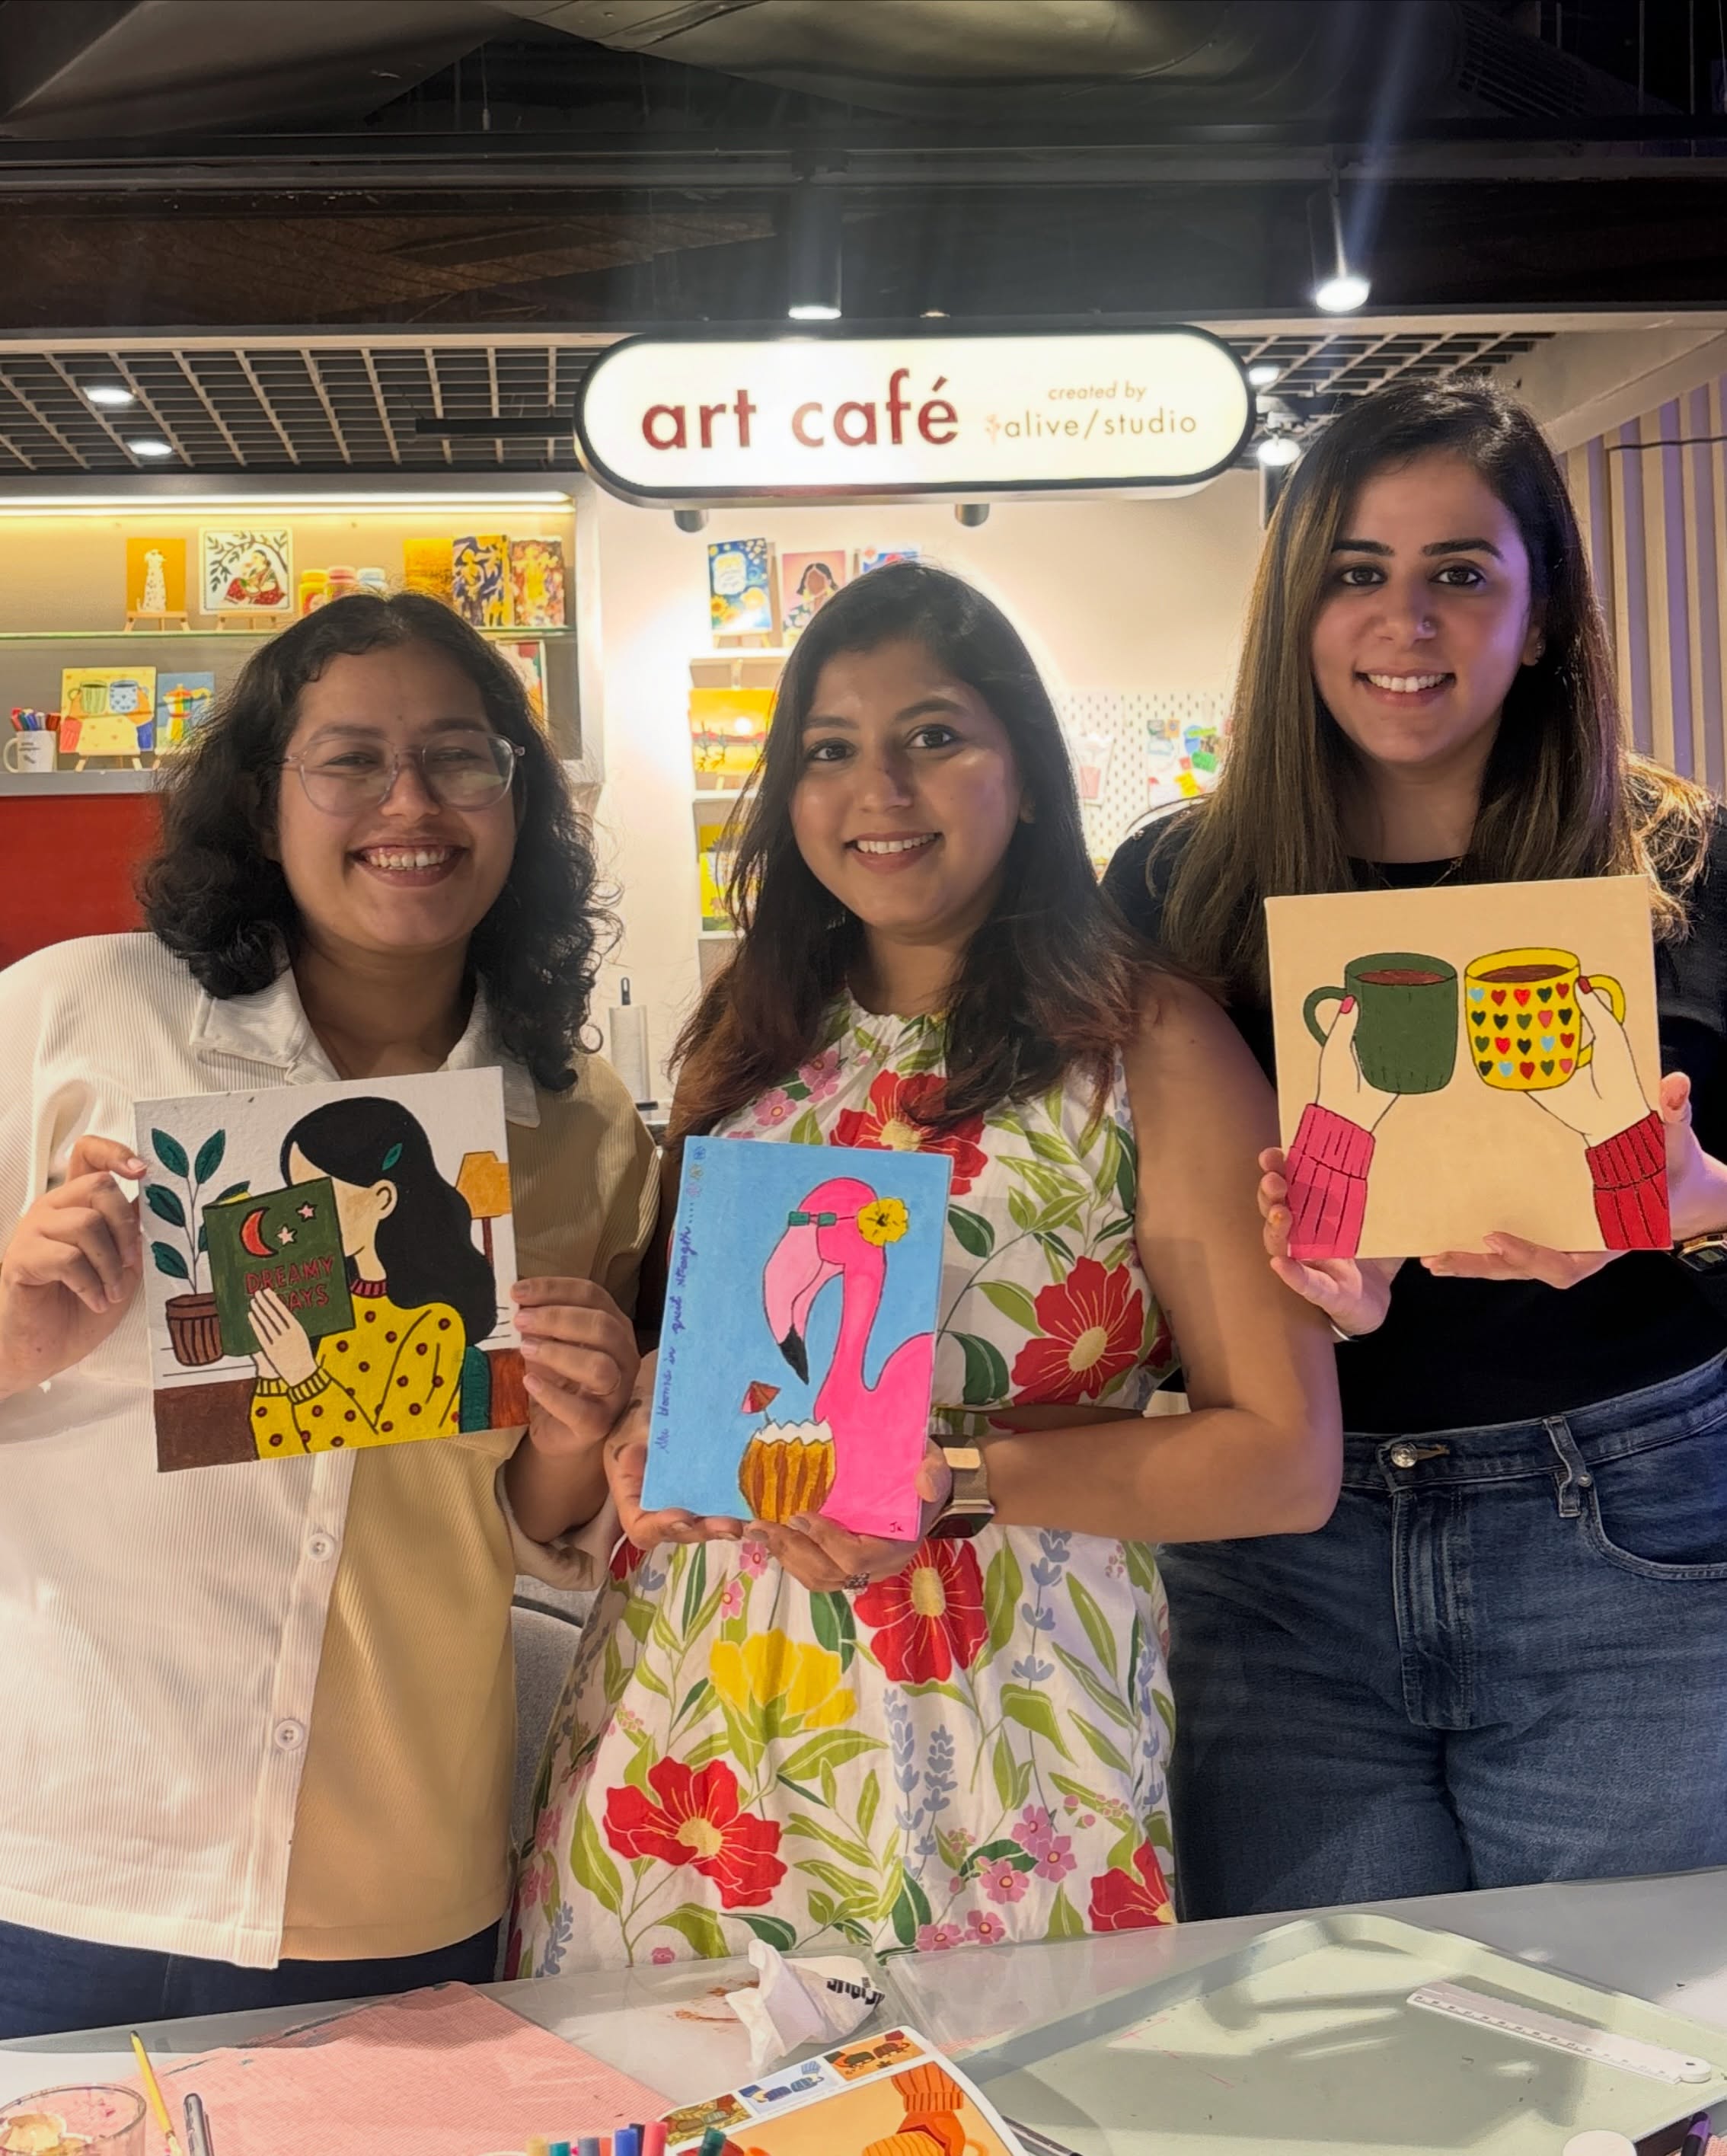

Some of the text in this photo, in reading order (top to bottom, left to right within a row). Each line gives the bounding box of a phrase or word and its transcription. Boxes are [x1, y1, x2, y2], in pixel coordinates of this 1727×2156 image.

[641, 367, 959, 451] art café
[1047, 380, 1147, 403] created by
[1004, 405, 1197, 441] alive/studio
[245, 1255, 334, 1296] DREAMY
[662, 1346, 676, 1365] in
